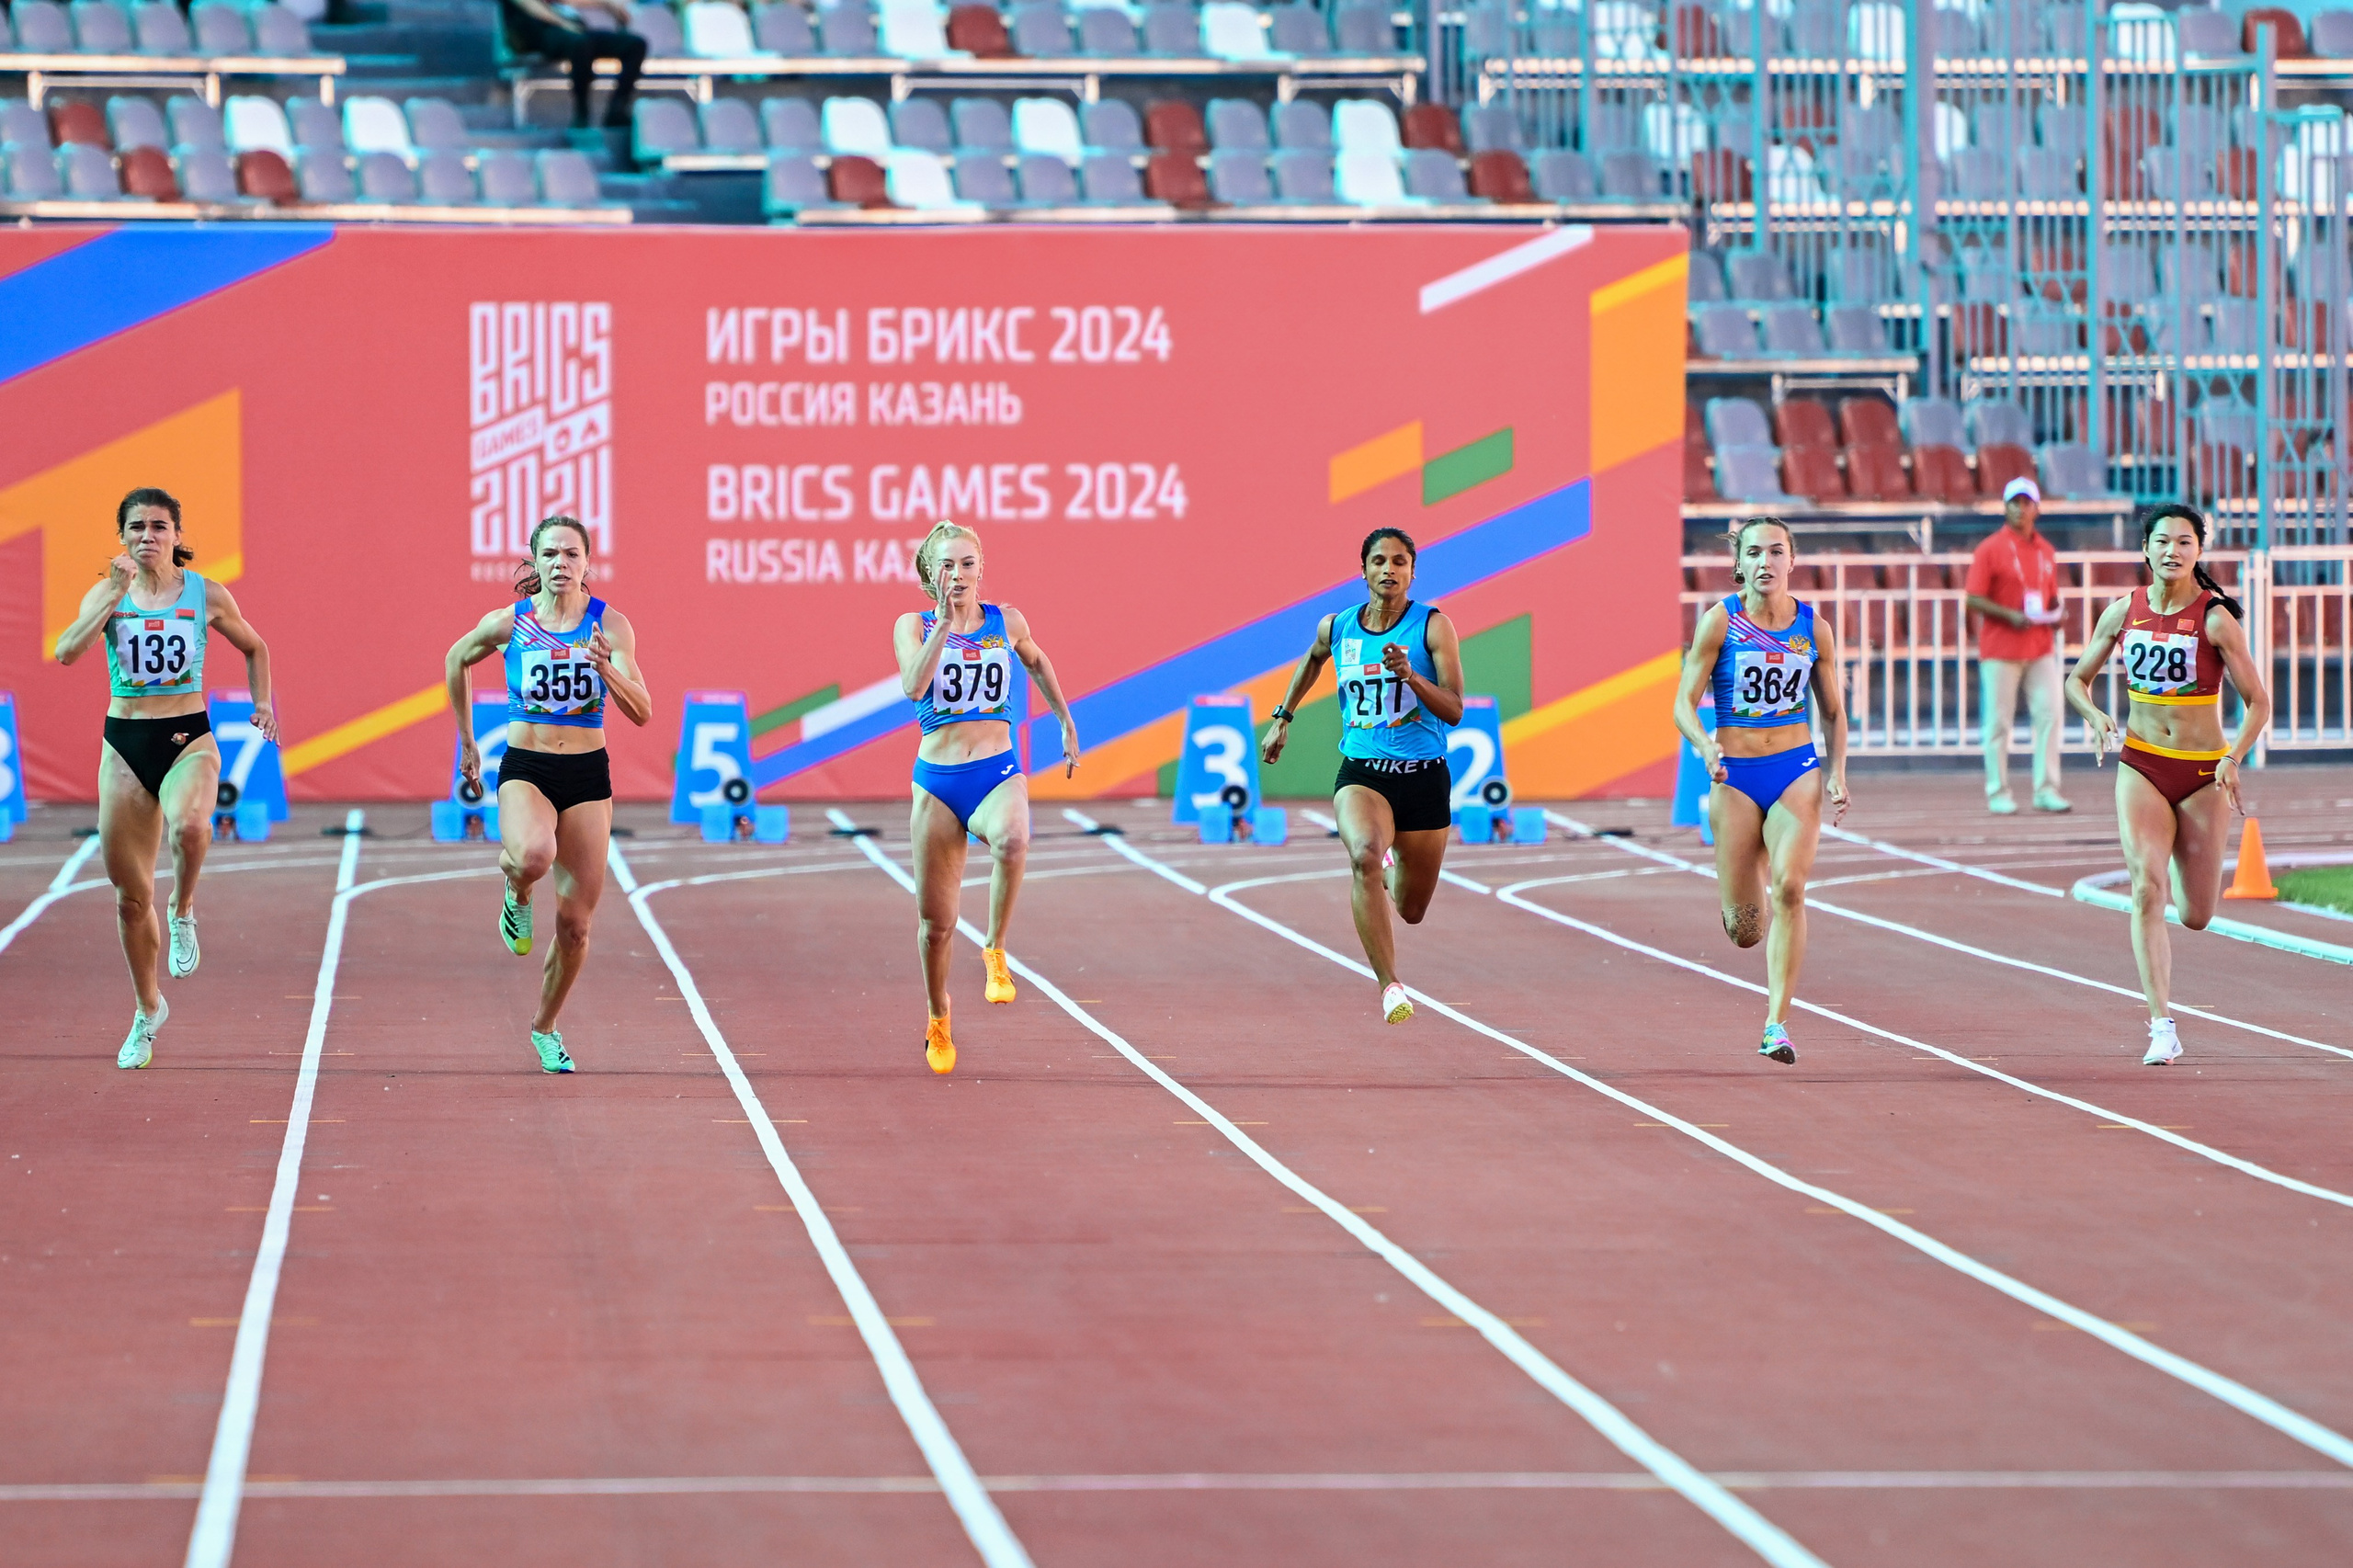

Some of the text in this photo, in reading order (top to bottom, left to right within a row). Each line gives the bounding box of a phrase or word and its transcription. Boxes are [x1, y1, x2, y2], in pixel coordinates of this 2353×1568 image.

[707, 306, 1173, 363] ИГРЫ БРИКС 2024
[470, 301, 611, 429] BRICS
[706, 382, 1022, 426] РОССИЯ КАЗАНЬ
[708, 462, 1188, 521] BRICS GAMES 2024
[707, 539, 844, 583] RUSSIA
[128, 634, 186, 674] 133
[2131, 642, 2188, 682] 228
[530, 663, 593, 701] 355
[943, 663, 1003, 702] 379
[1348, 676, 1403, 716] 277
[1743, 666, 1802, 704] 364
[215, 722, 267, 792] 7
[688, 722, 743, 809] 5
[1191, 724, 1249, 809] 3
[1365, 758, 1419, 773] NIKE
[1447, 727, 1495, 812] 2
